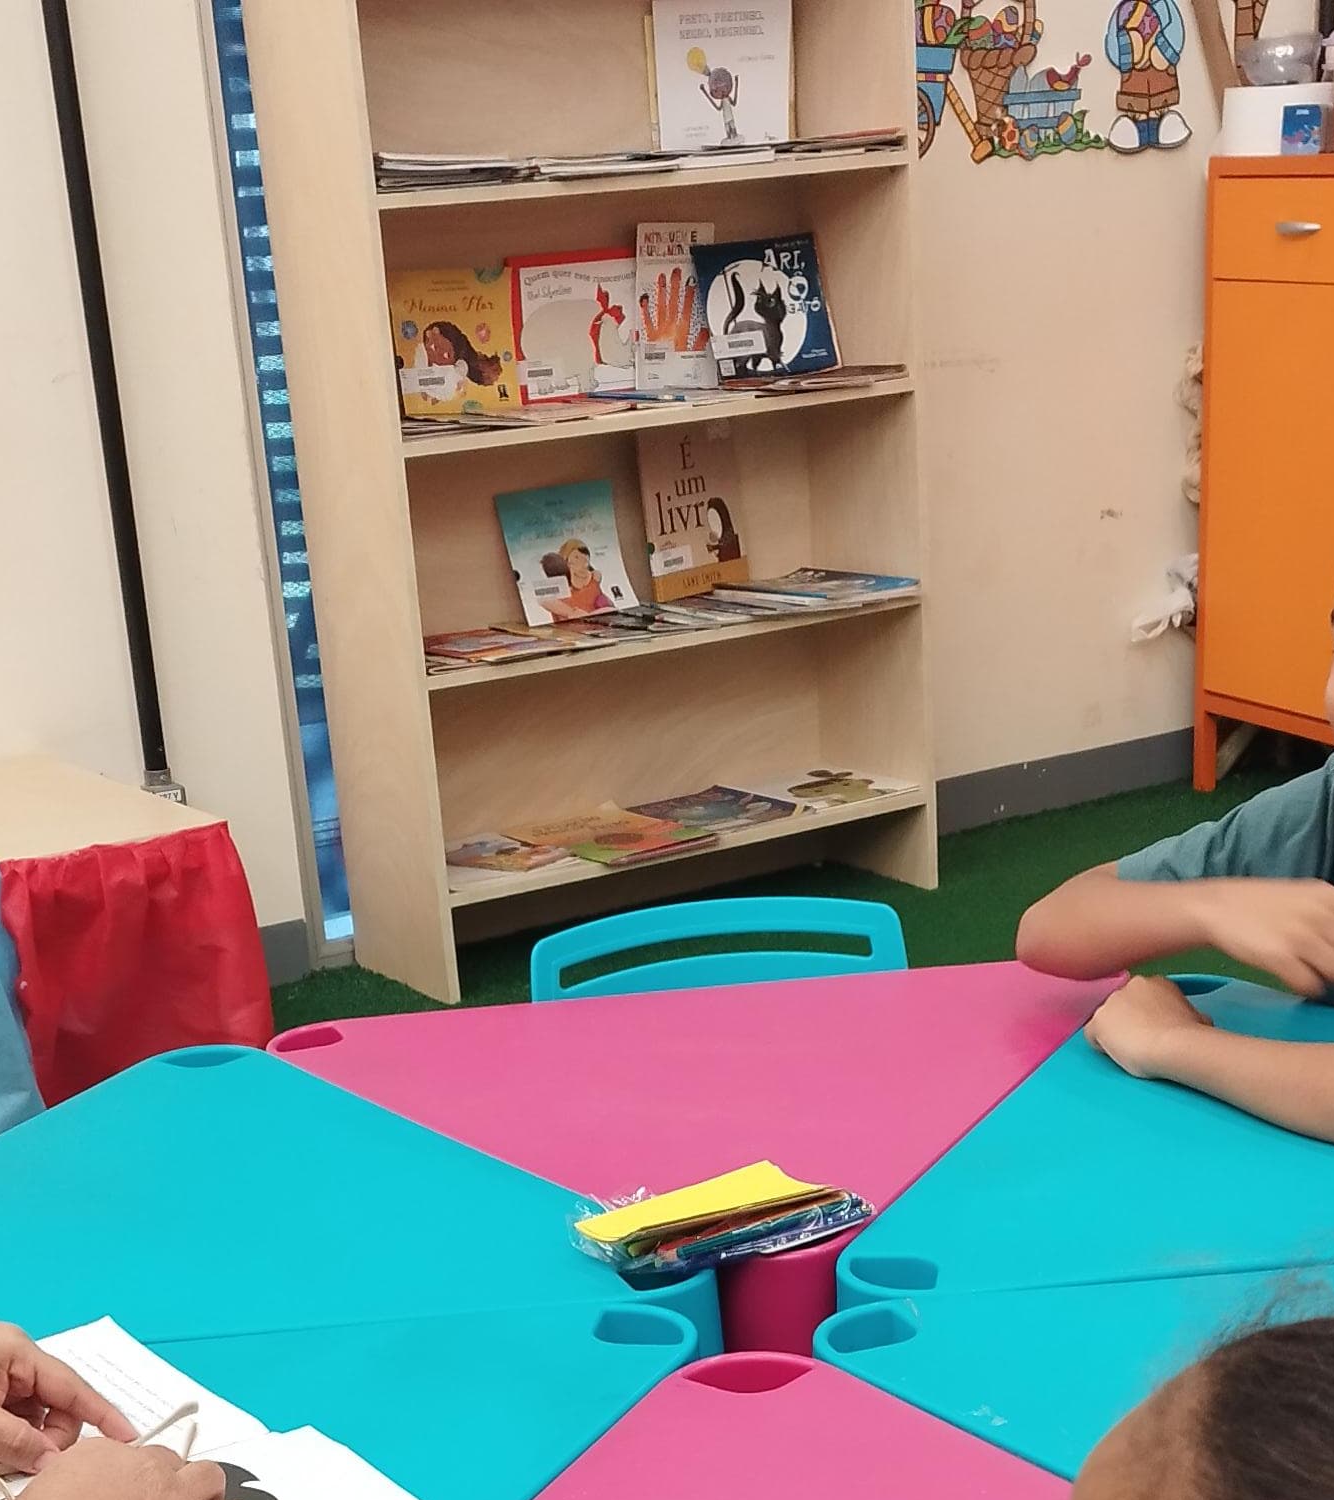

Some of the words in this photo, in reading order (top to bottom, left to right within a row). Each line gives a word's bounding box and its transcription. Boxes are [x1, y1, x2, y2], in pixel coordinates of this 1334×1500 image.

[763, 248, 805, 271] ARI,
[524, 270, 550, 286] Quem
[552, 270, 571, 279] quer
[574, 272, 590, 282] este
[462, 295, 495, 312] Flor
[680, 435, 695, 470] É
[674, 475, 706, 498] um
